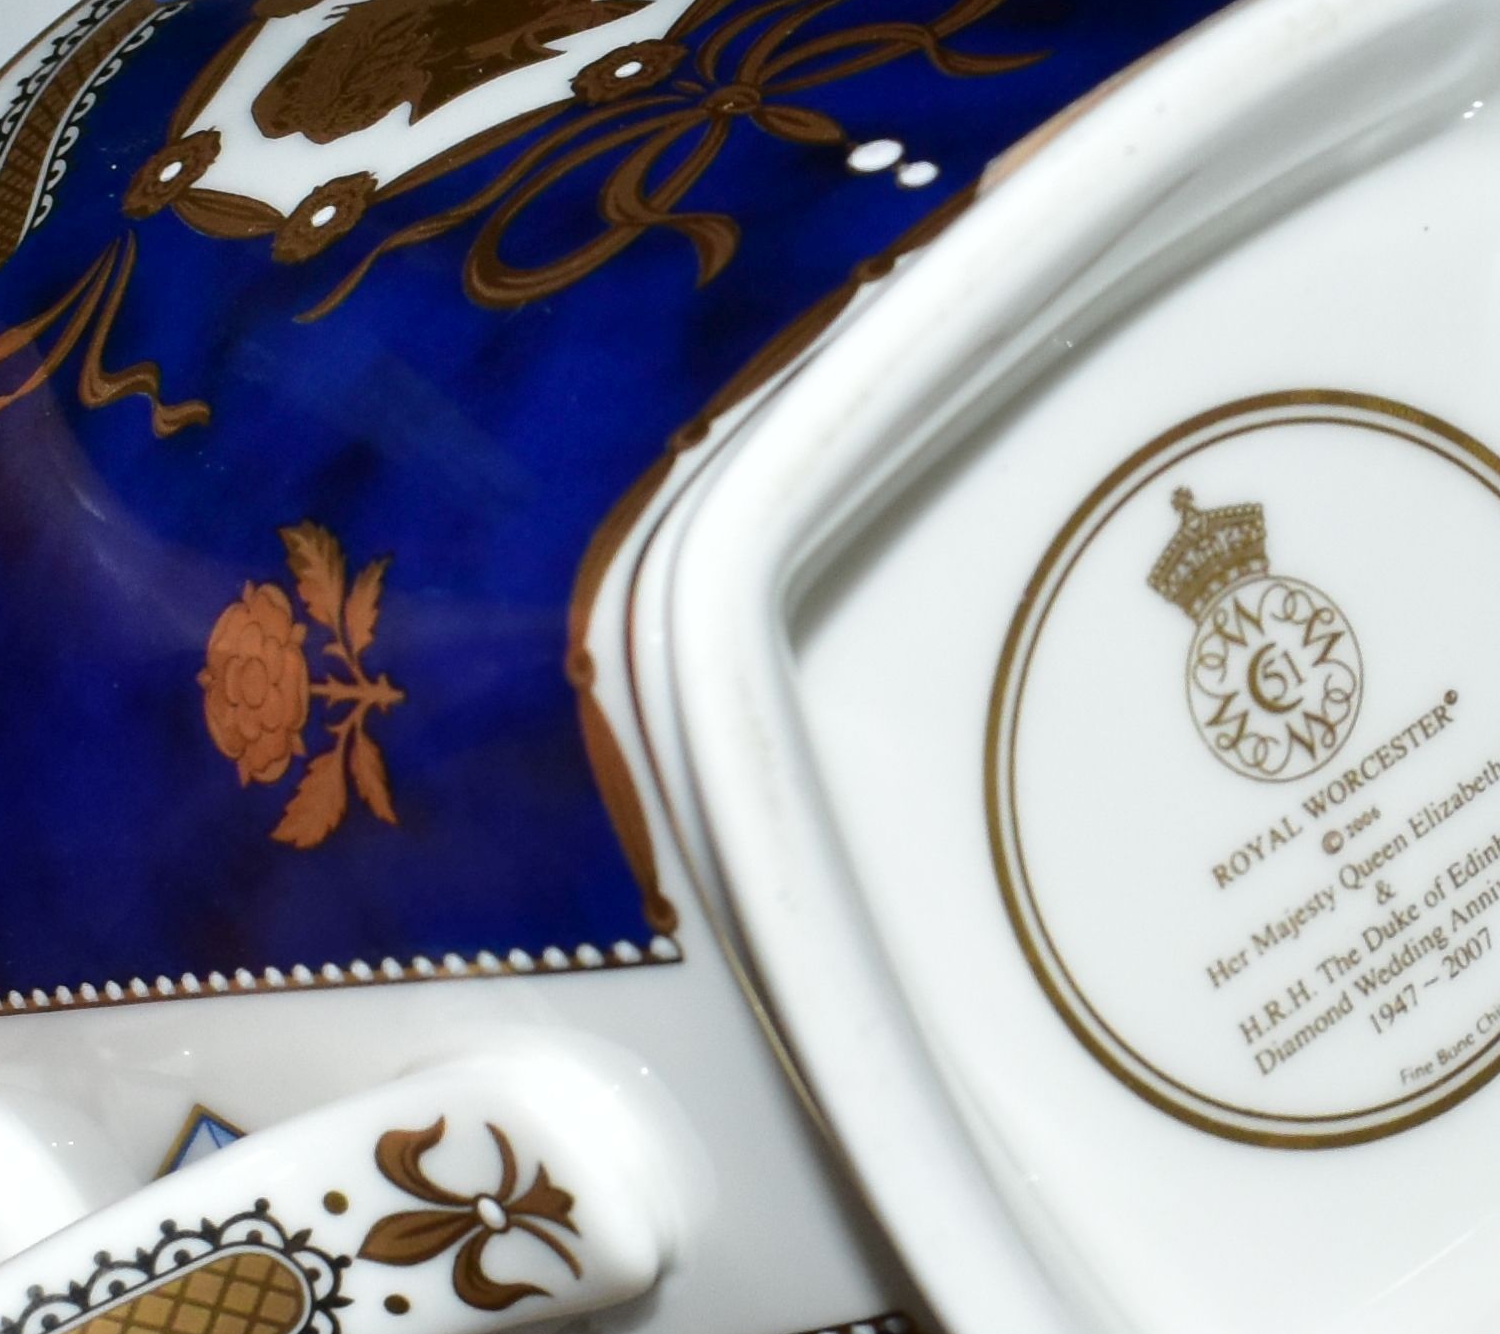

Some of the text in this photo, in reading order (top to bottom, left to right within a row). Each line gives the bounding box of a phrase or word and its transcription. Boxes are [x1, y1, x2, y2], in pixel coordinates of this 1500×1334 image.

[1211, 817, 1303, 889] ROYAL
[1374, 880, 1397, 905] &
[1206, 950, 1249, 988] Her
[1251, 884, 1337, 955] Majesty
[1339, 833, 1409, 890] Queen
[1239, 980, 1317, 1045] H.R.H.
[1316, 947, 1362, 984] The
[1361, 903, 1420, 952] Duke
[1424, 876, 1448, 908] of
[1253, 992, 1353, 1075] Diamond
[1353, 926, 1449, 998] Wedding
[1368, 983, 1419, 1035] 1947
[1442, 927, 1493, 980] 2007
[1400, 1063, 1434, 1085] Fine
[1436, 1032, 1476, 1064] Bone
